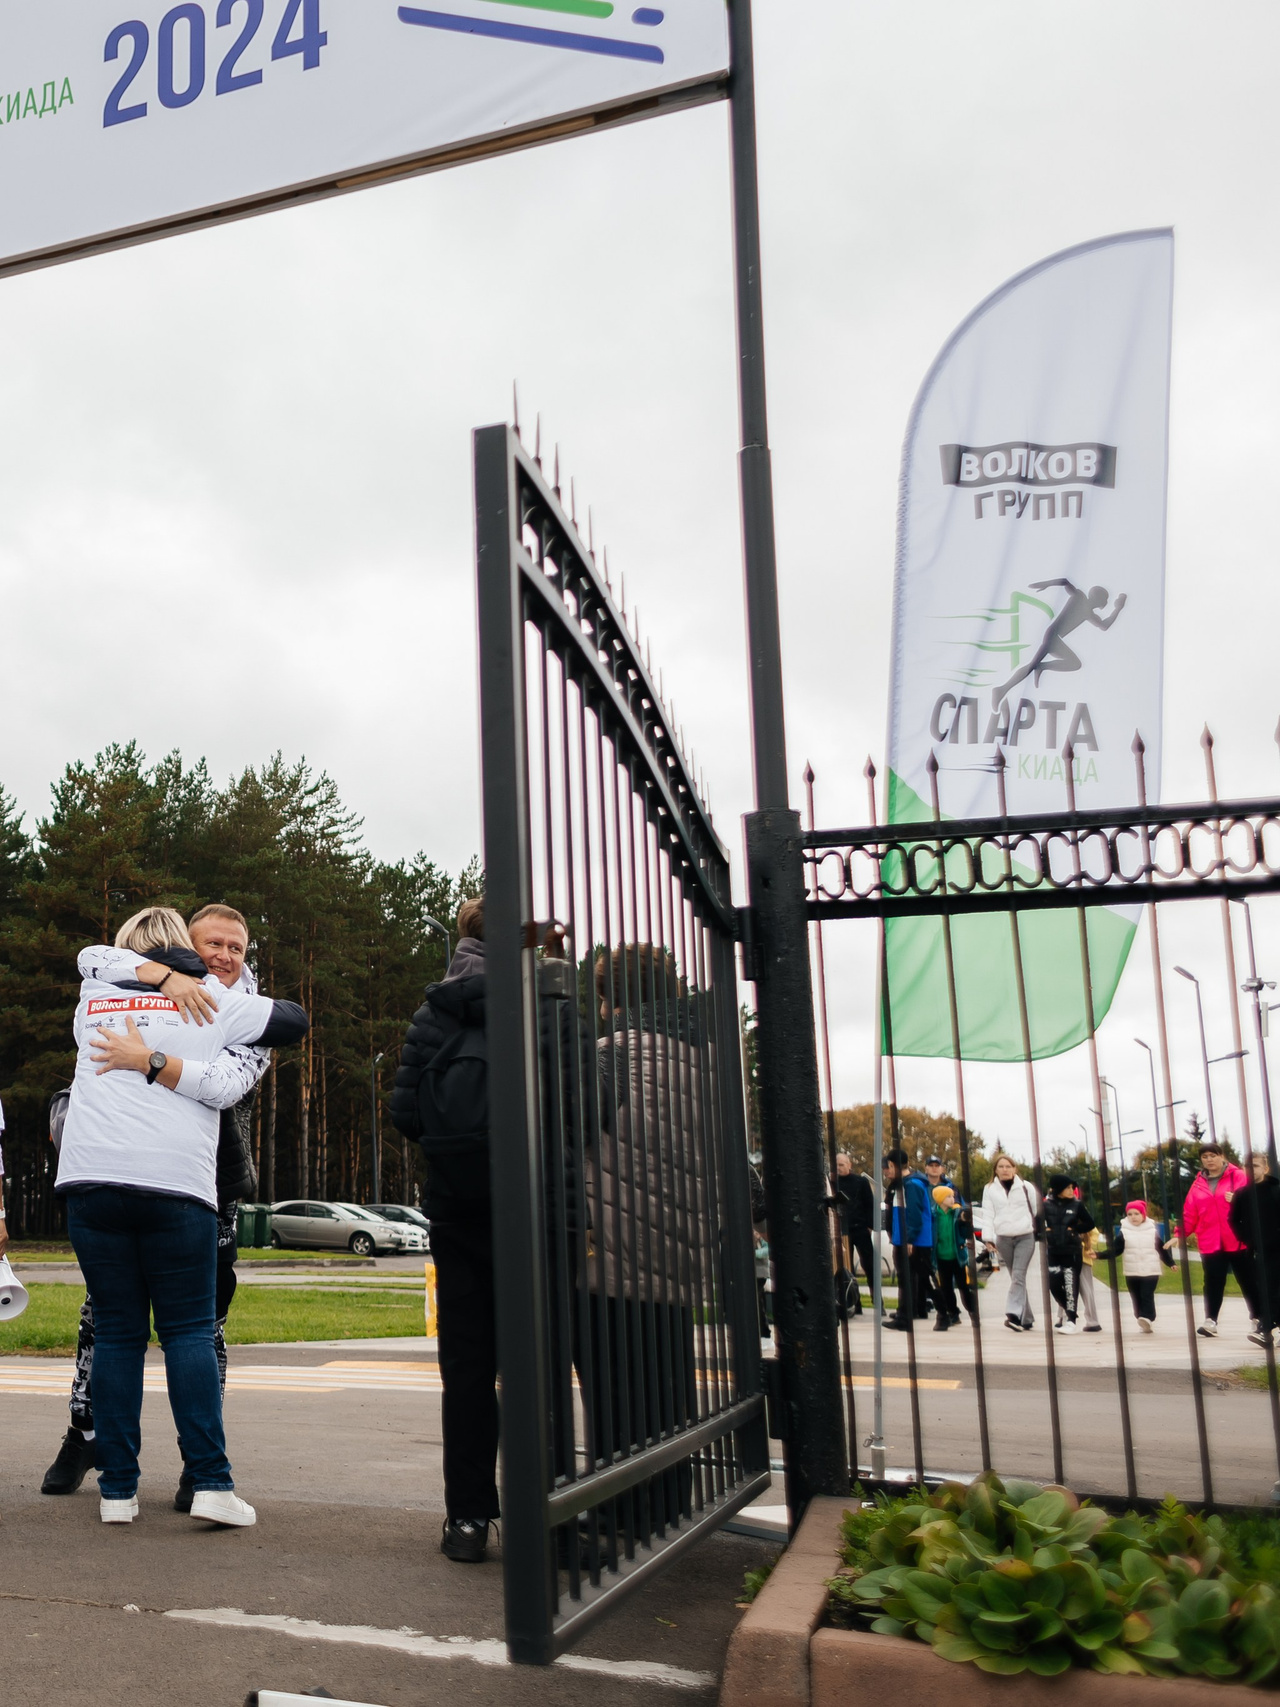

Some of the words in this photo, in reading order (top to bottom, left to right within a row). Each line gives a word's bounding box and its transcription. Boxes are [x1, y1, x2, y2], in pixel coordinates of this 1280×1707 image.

[103, 0, 328, 129] 2024
[959, 447, 1098, 483] ВОЛКОВ
[973, 489, 1084, 521] ГРУПП
[929, 692, 1100, 752] СПАРТА
[90, 1000, 131, 1012] ВОЛКОВ
[134, 997, 174, 1009] ГРУПП
